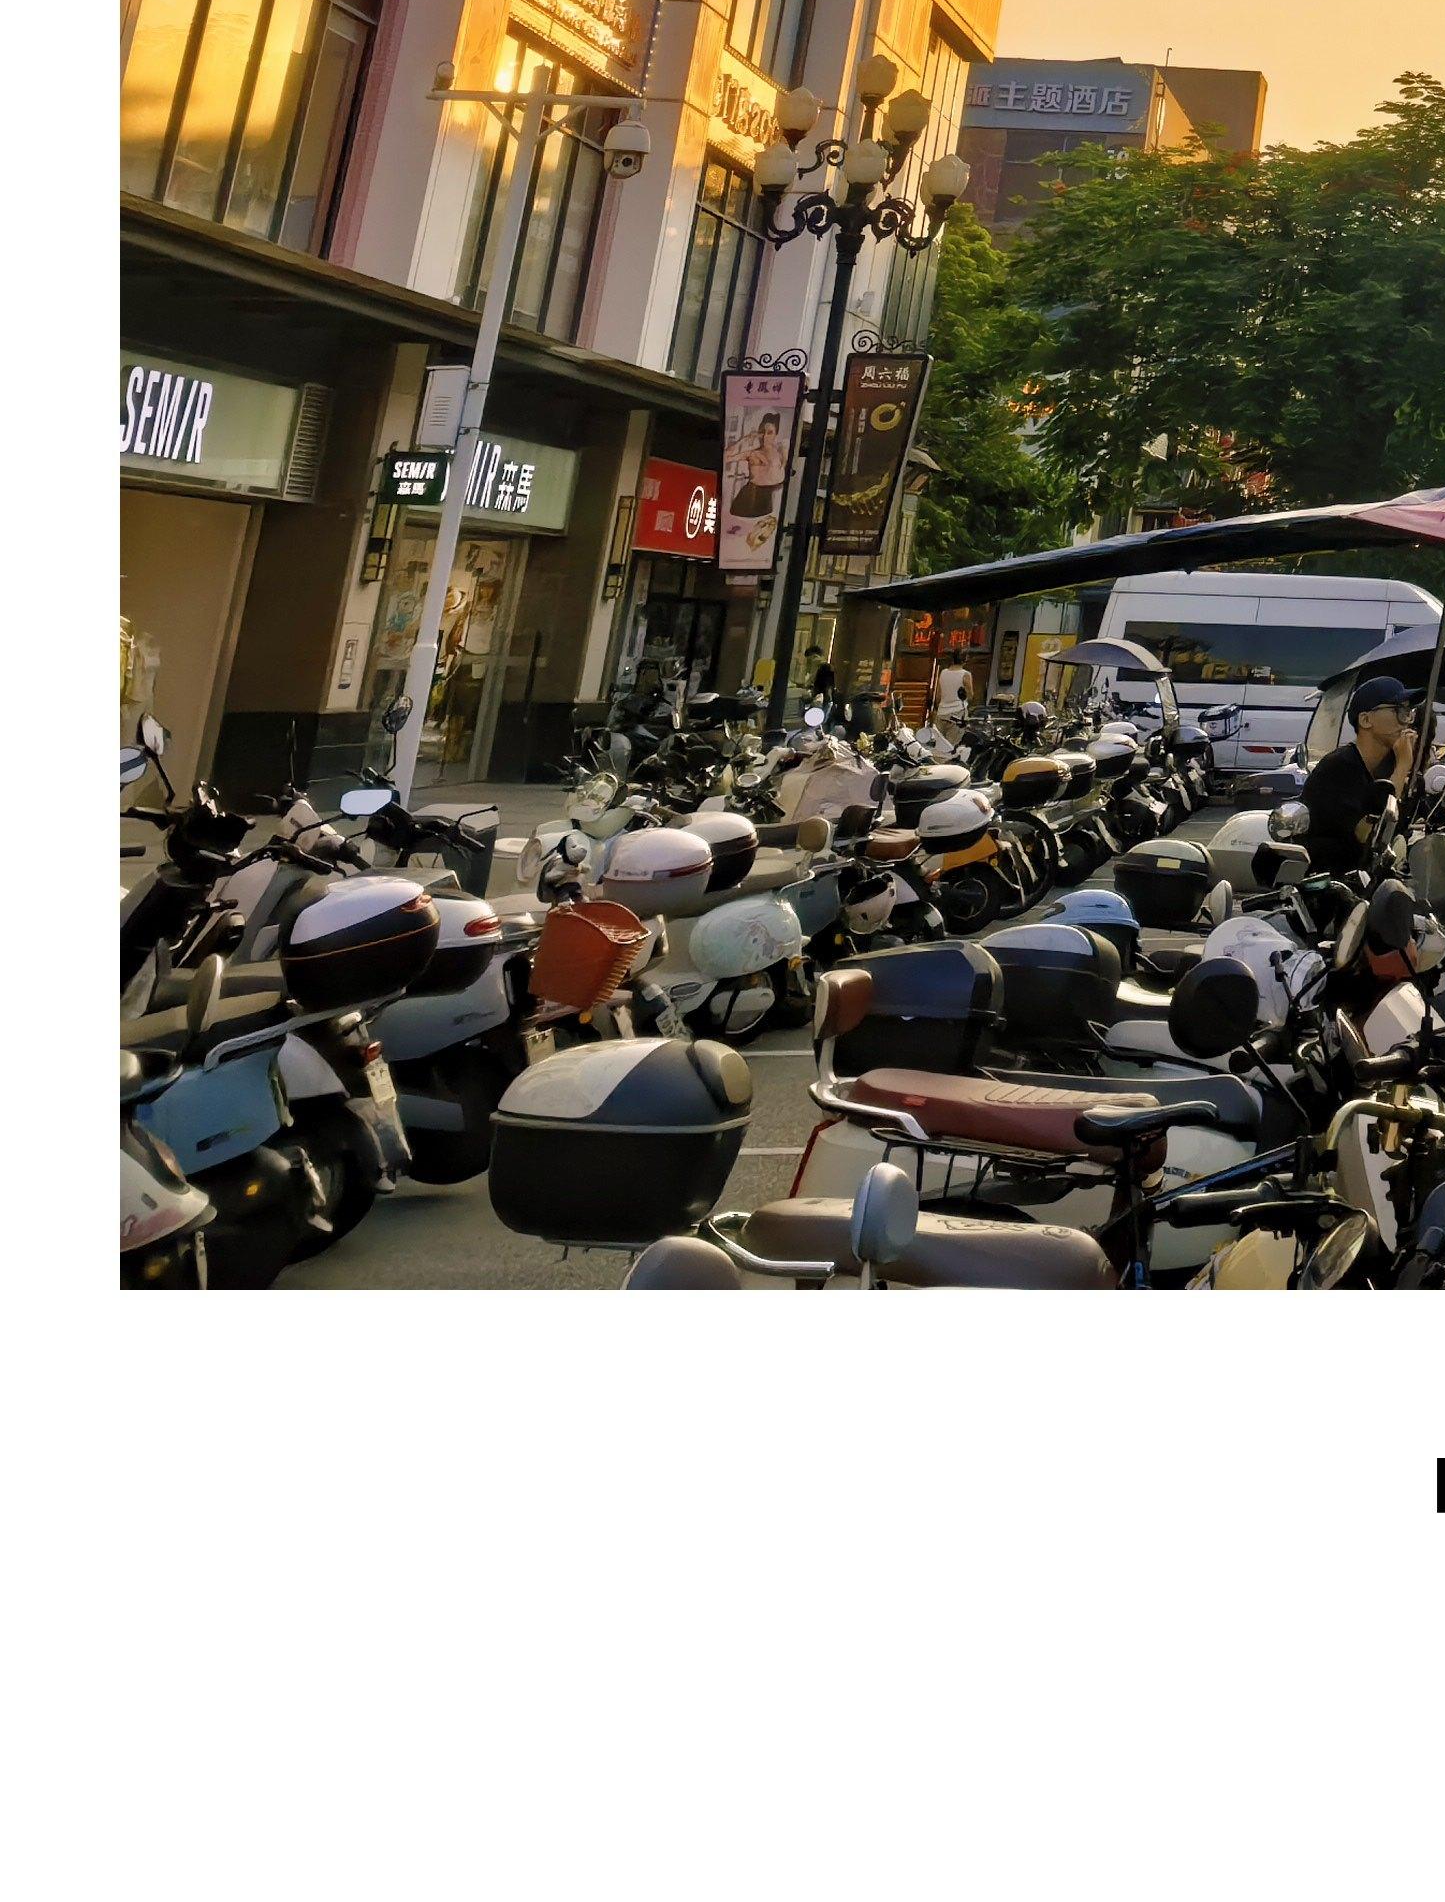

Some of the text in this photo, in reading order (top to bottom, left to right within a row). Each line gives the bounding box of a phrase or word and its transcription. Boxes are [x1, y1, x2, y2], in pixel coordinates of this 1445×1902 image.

[861, 365, 910, 381] 周六福
[119, 365, 214, 464] SEMIR
[392, 461, 438, 480] SEMIR
